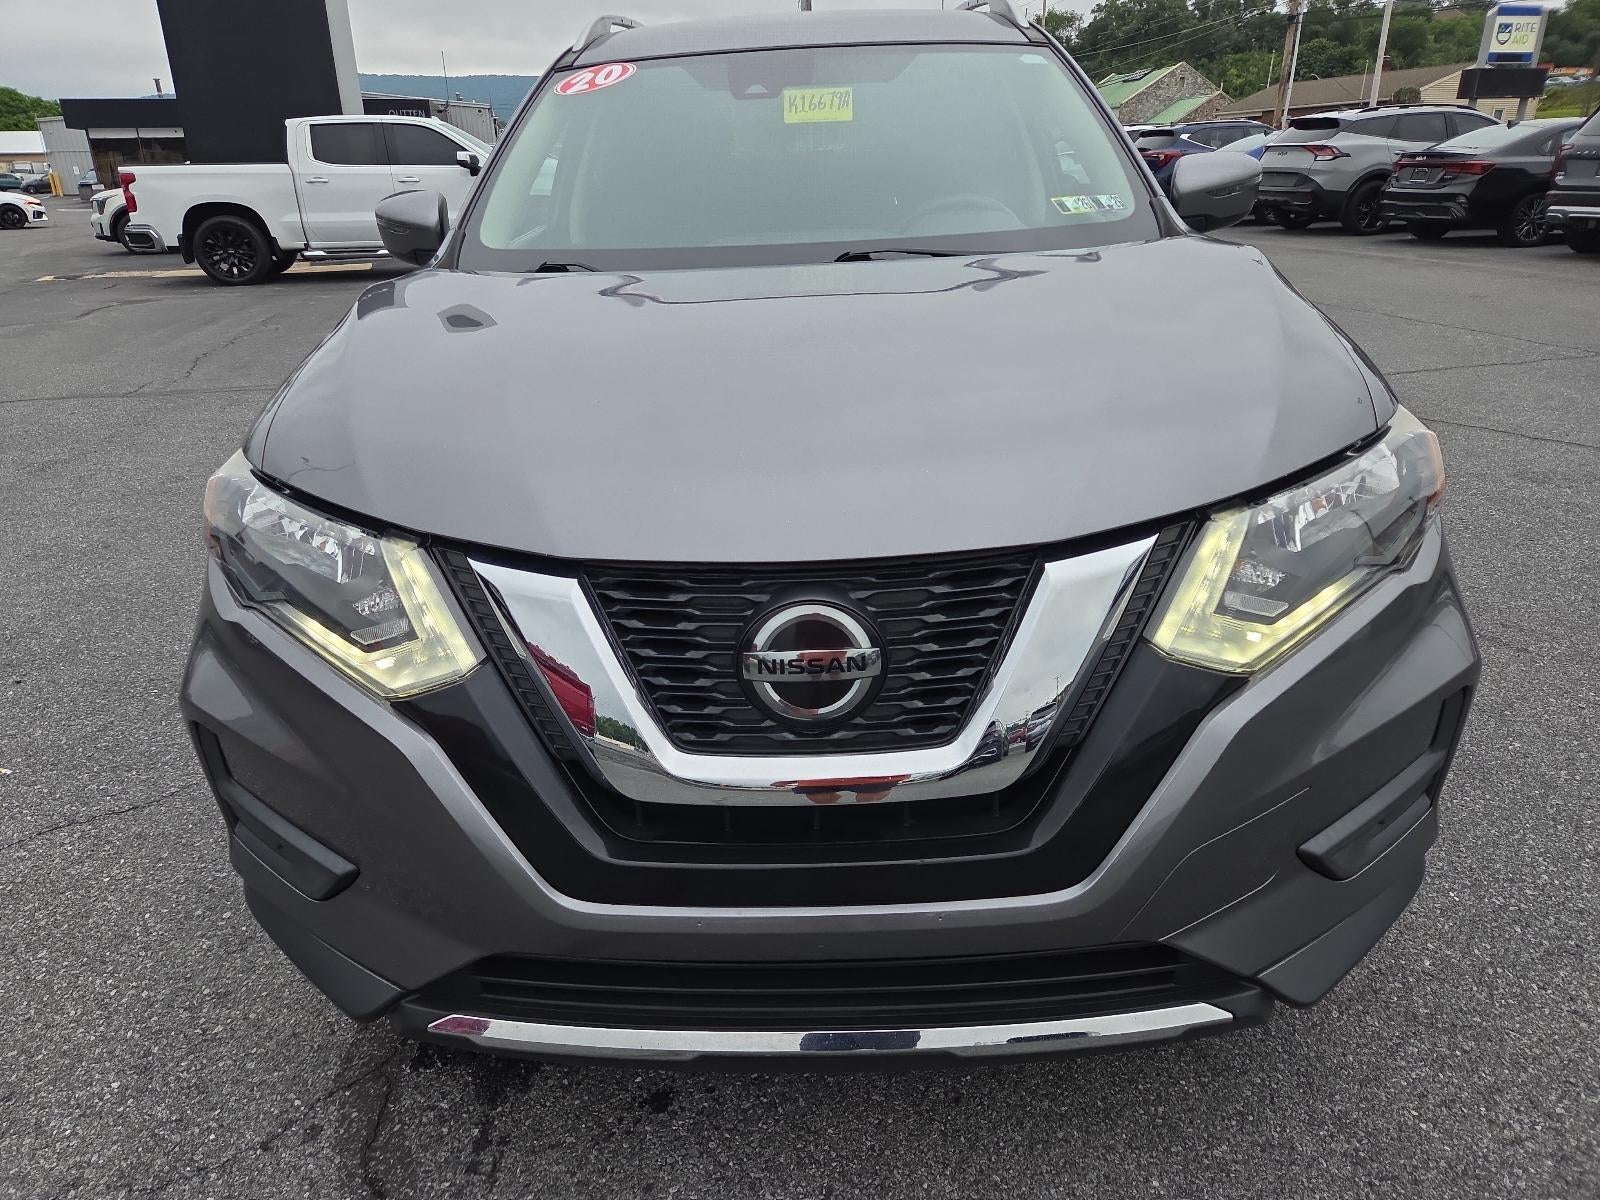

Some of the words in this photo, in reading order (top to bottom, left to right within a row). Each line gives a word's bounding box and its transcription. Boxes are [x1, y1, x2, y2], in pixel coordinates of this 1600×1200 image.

[1514, 22, 1537, 33] RITE
[1511, 34, 1529, 45] AID
[566, 64, 623, 93] 20
[757, 653, 866, 675] NISSAN
